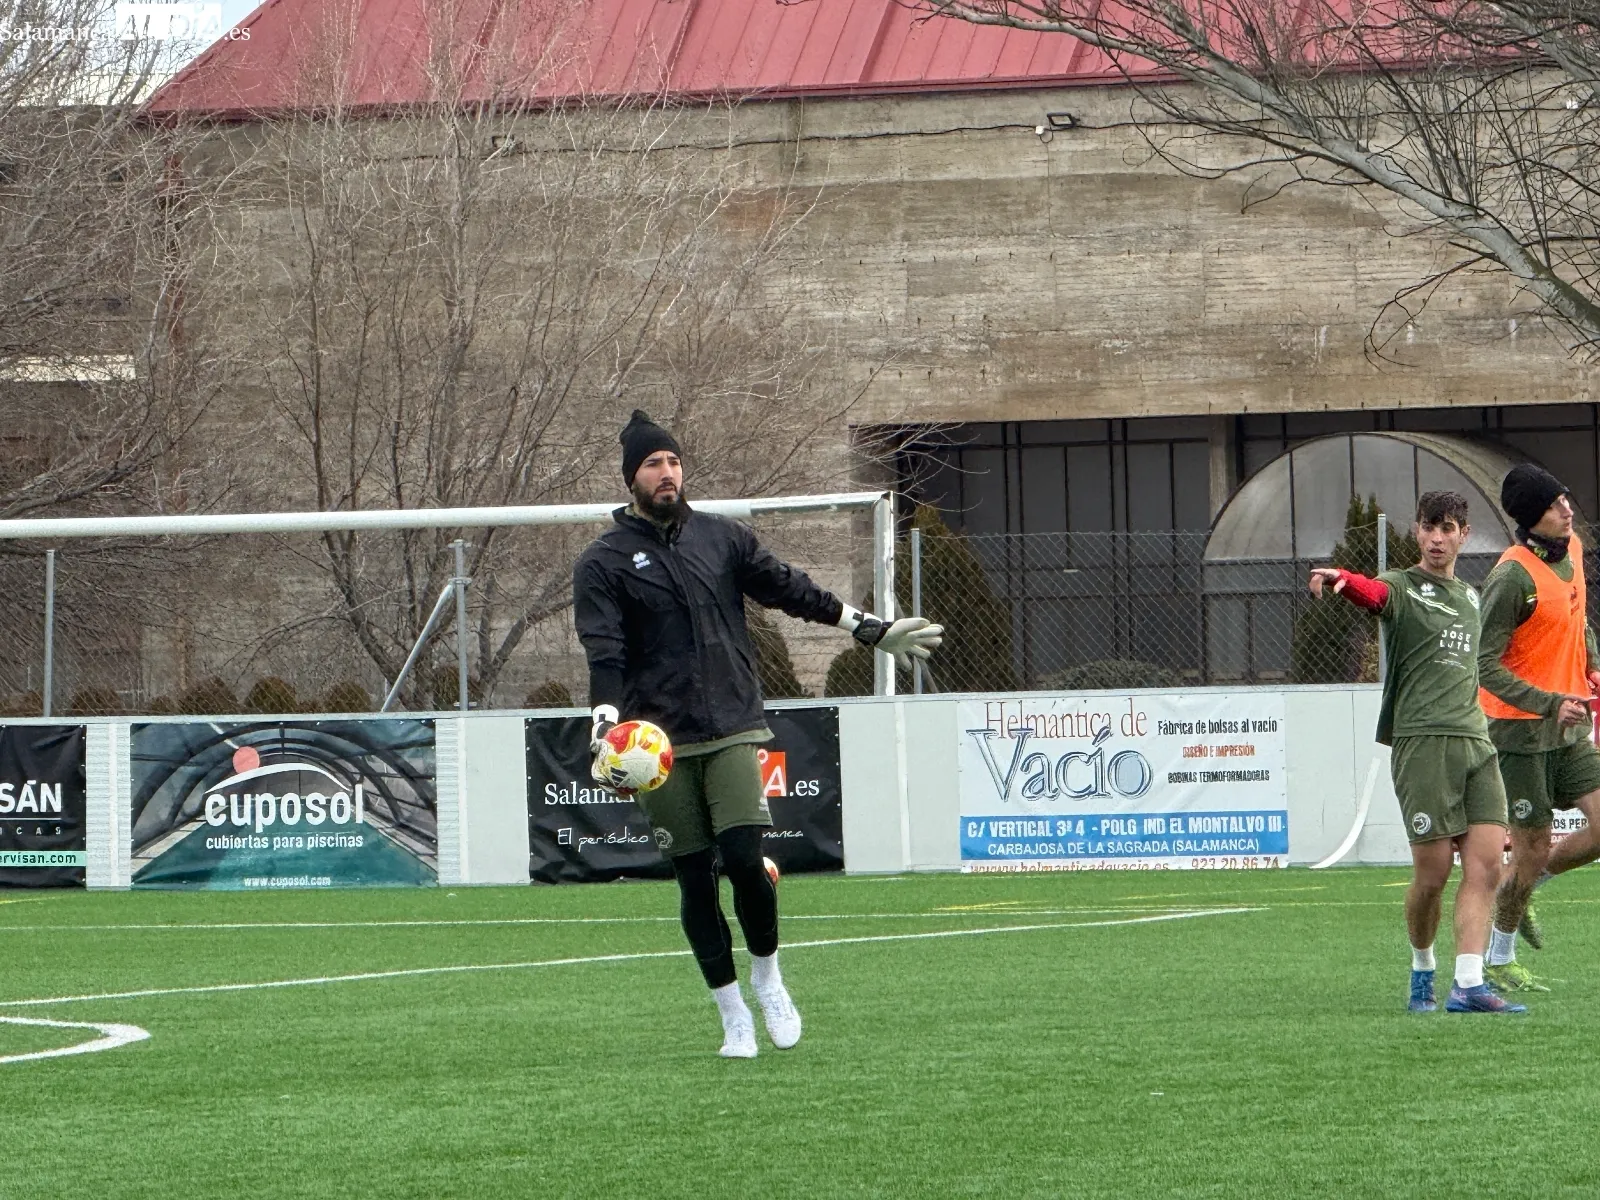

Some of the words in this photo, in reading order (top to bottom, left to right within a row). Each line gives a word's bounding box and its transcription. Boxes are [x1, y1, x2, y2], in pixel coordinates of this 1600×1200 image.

[1441, 629, 1472, 643] JOSE
[985, 701, 1113, 739] Helmántica
[1121, 698, 1148, 737] de
[1157, 720, 1194, 736] Fábrica
[1196, 720, 1207, 735] de
[1208, 718, 1240, 734] bolsas
[1241, 718, 1251, 734] al
[1252, 716, 1278, 733] vacío
[1210, 745, 1215, 757] E
[966, 727, 1153, 803] Vacío
[205, 784, 364, 832] cuposol
[967, 821, 984, 838] C/
[989, 819, 1053, 837] VERTICAL
[1075, 817, 1085, 836] 4
[1100, 816, 1137, 835] POLG
[1143, 815, 1166, 834] IND
[1169, 816, 1186, 833] EL
[1188, 814, 1264, 834] MONTALVO
[206, 835, 269, 850] cubiertas
[273, 836, 303, 850] para
[307, 834, 364, 849] piscinas
[557, 828, 572, 845] El
[578, 826, 649, 852] periódico
[988, 843, 1066, 855] CARBAJOSA
[1068, 842, 1085, 854] DE
[1088, 841, 1107, 852] LA
[1108, 841, 1169, 854] SAGRADA
[1173, 837, 1260, 854] (SALAMANCA)
